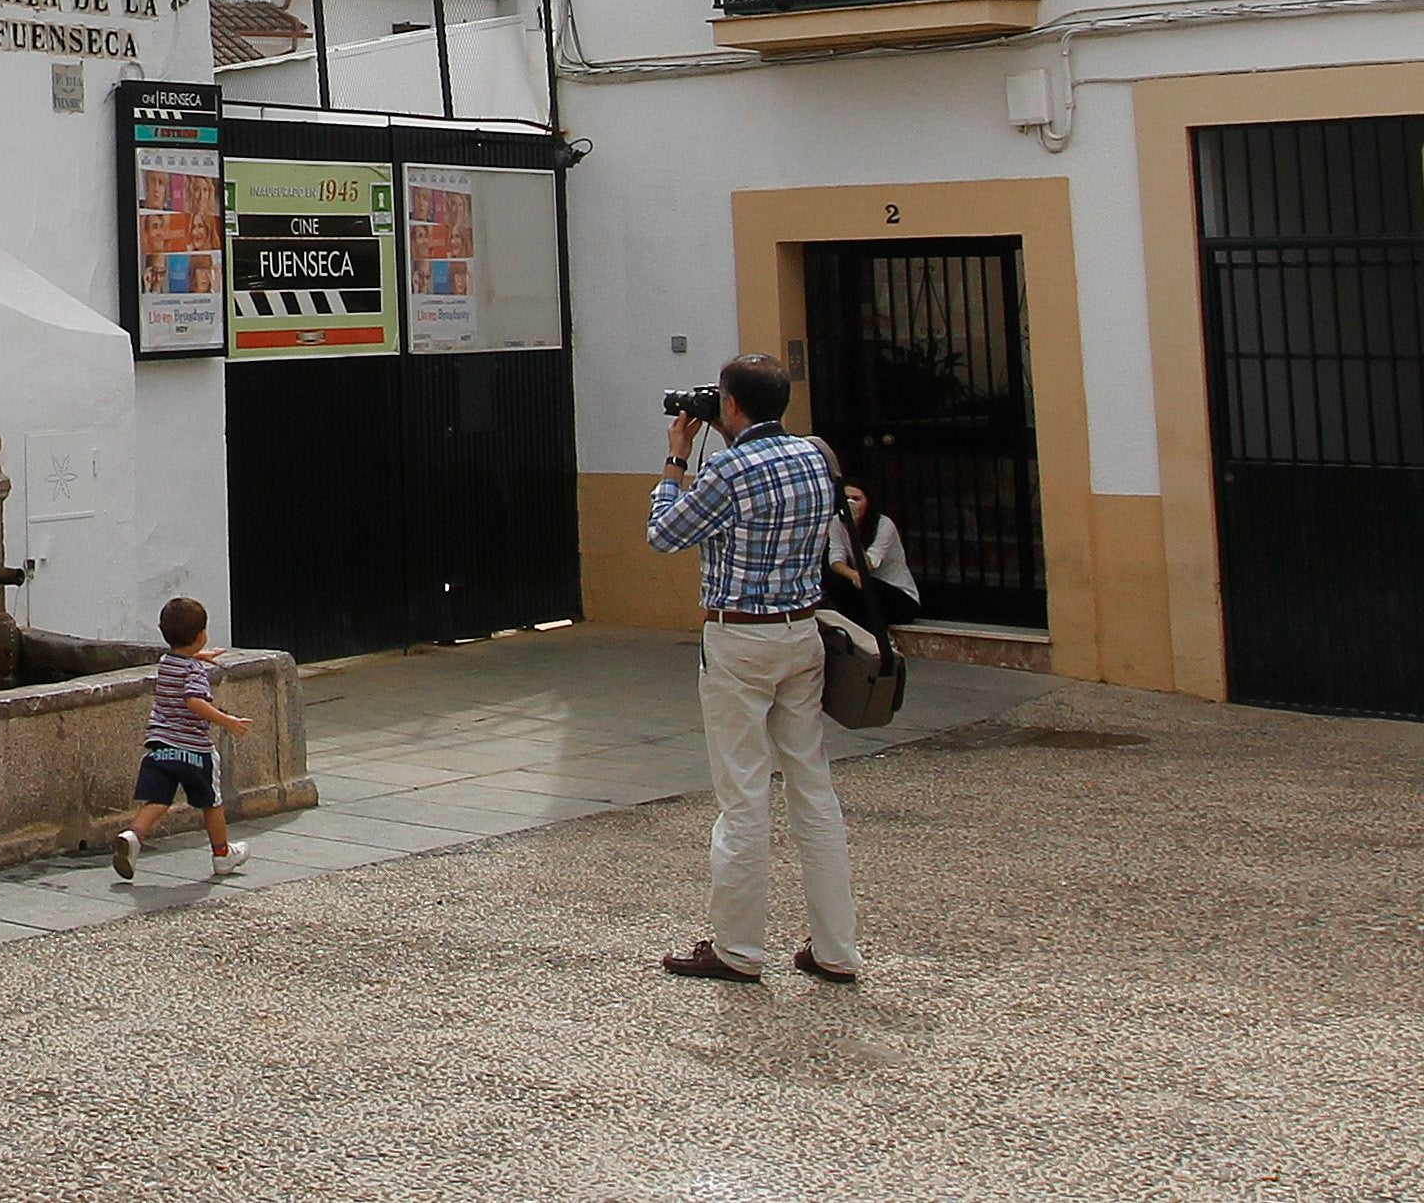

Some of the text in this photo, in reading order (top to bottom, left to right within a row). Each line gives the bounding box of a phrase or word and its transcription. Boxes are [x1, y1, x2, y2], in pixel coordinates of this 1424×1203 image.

[160, 91, 202, 107] FUENSECA
[317, 179, 358, 203] 1945
[885, 204, 900, 224] 2
[290, 218, 320, 235] CINE
[259, 251, 354, 278] FUENSECA
